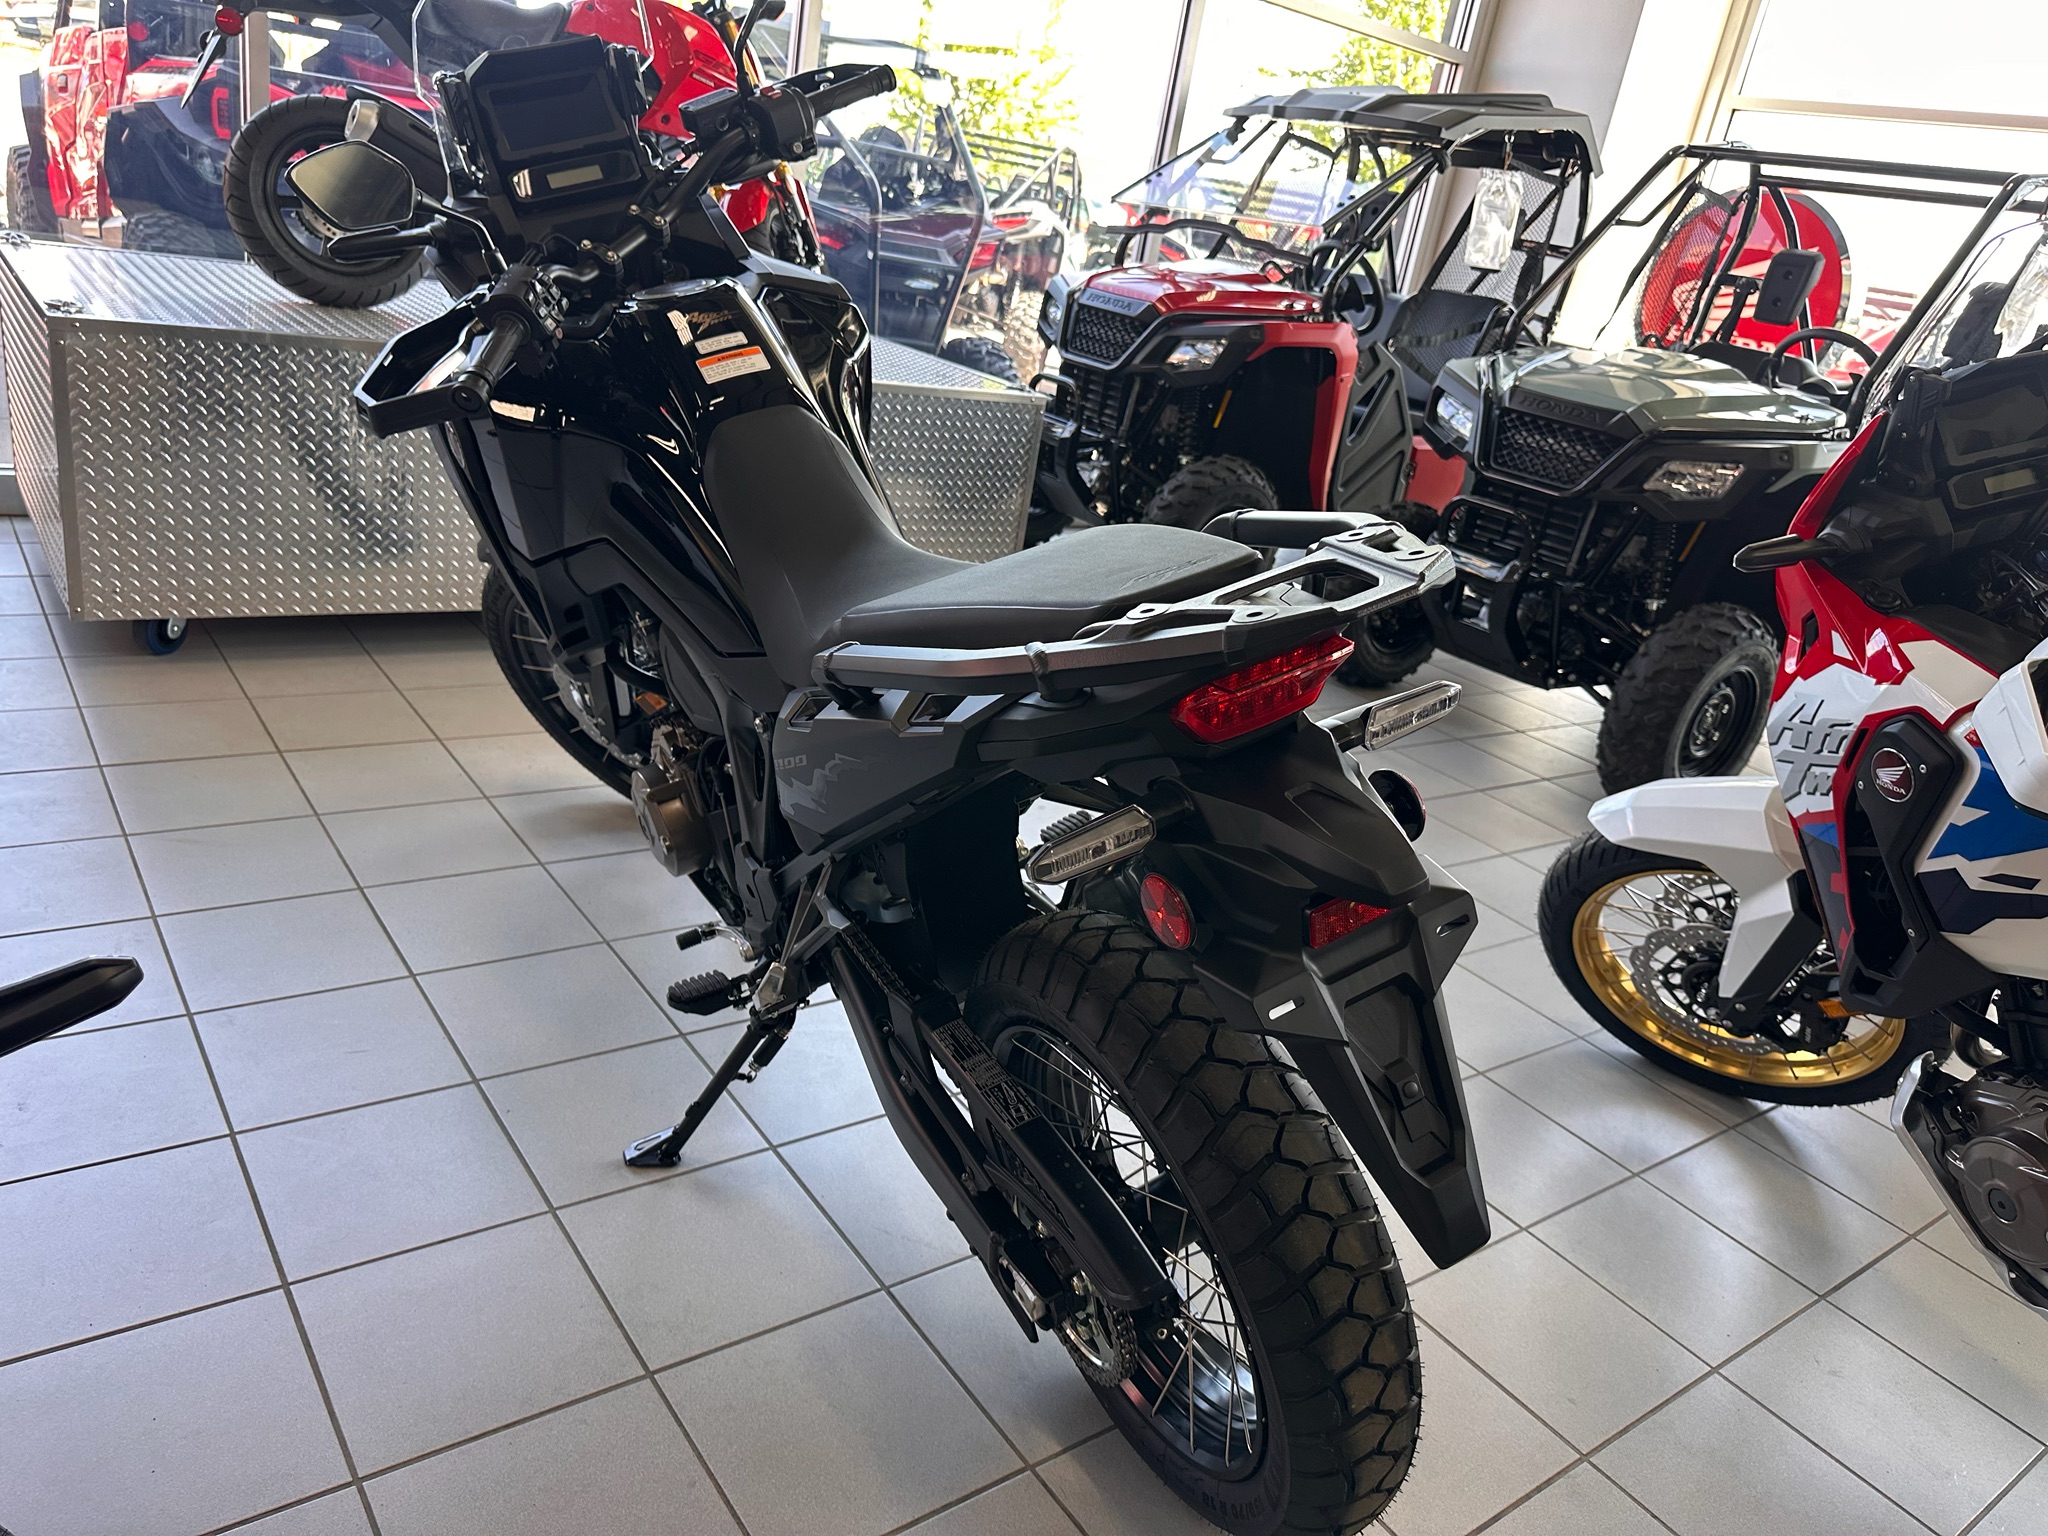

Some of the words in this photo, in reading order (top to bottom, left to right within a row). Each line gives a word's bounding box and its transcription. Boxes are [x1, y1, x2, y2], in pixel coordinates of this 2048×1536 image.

[1086, 293, 1133, 312] HONDA
[1519, 396, 1600, 423] HONDA
[1876, 778, 1907, 796] HONDA
